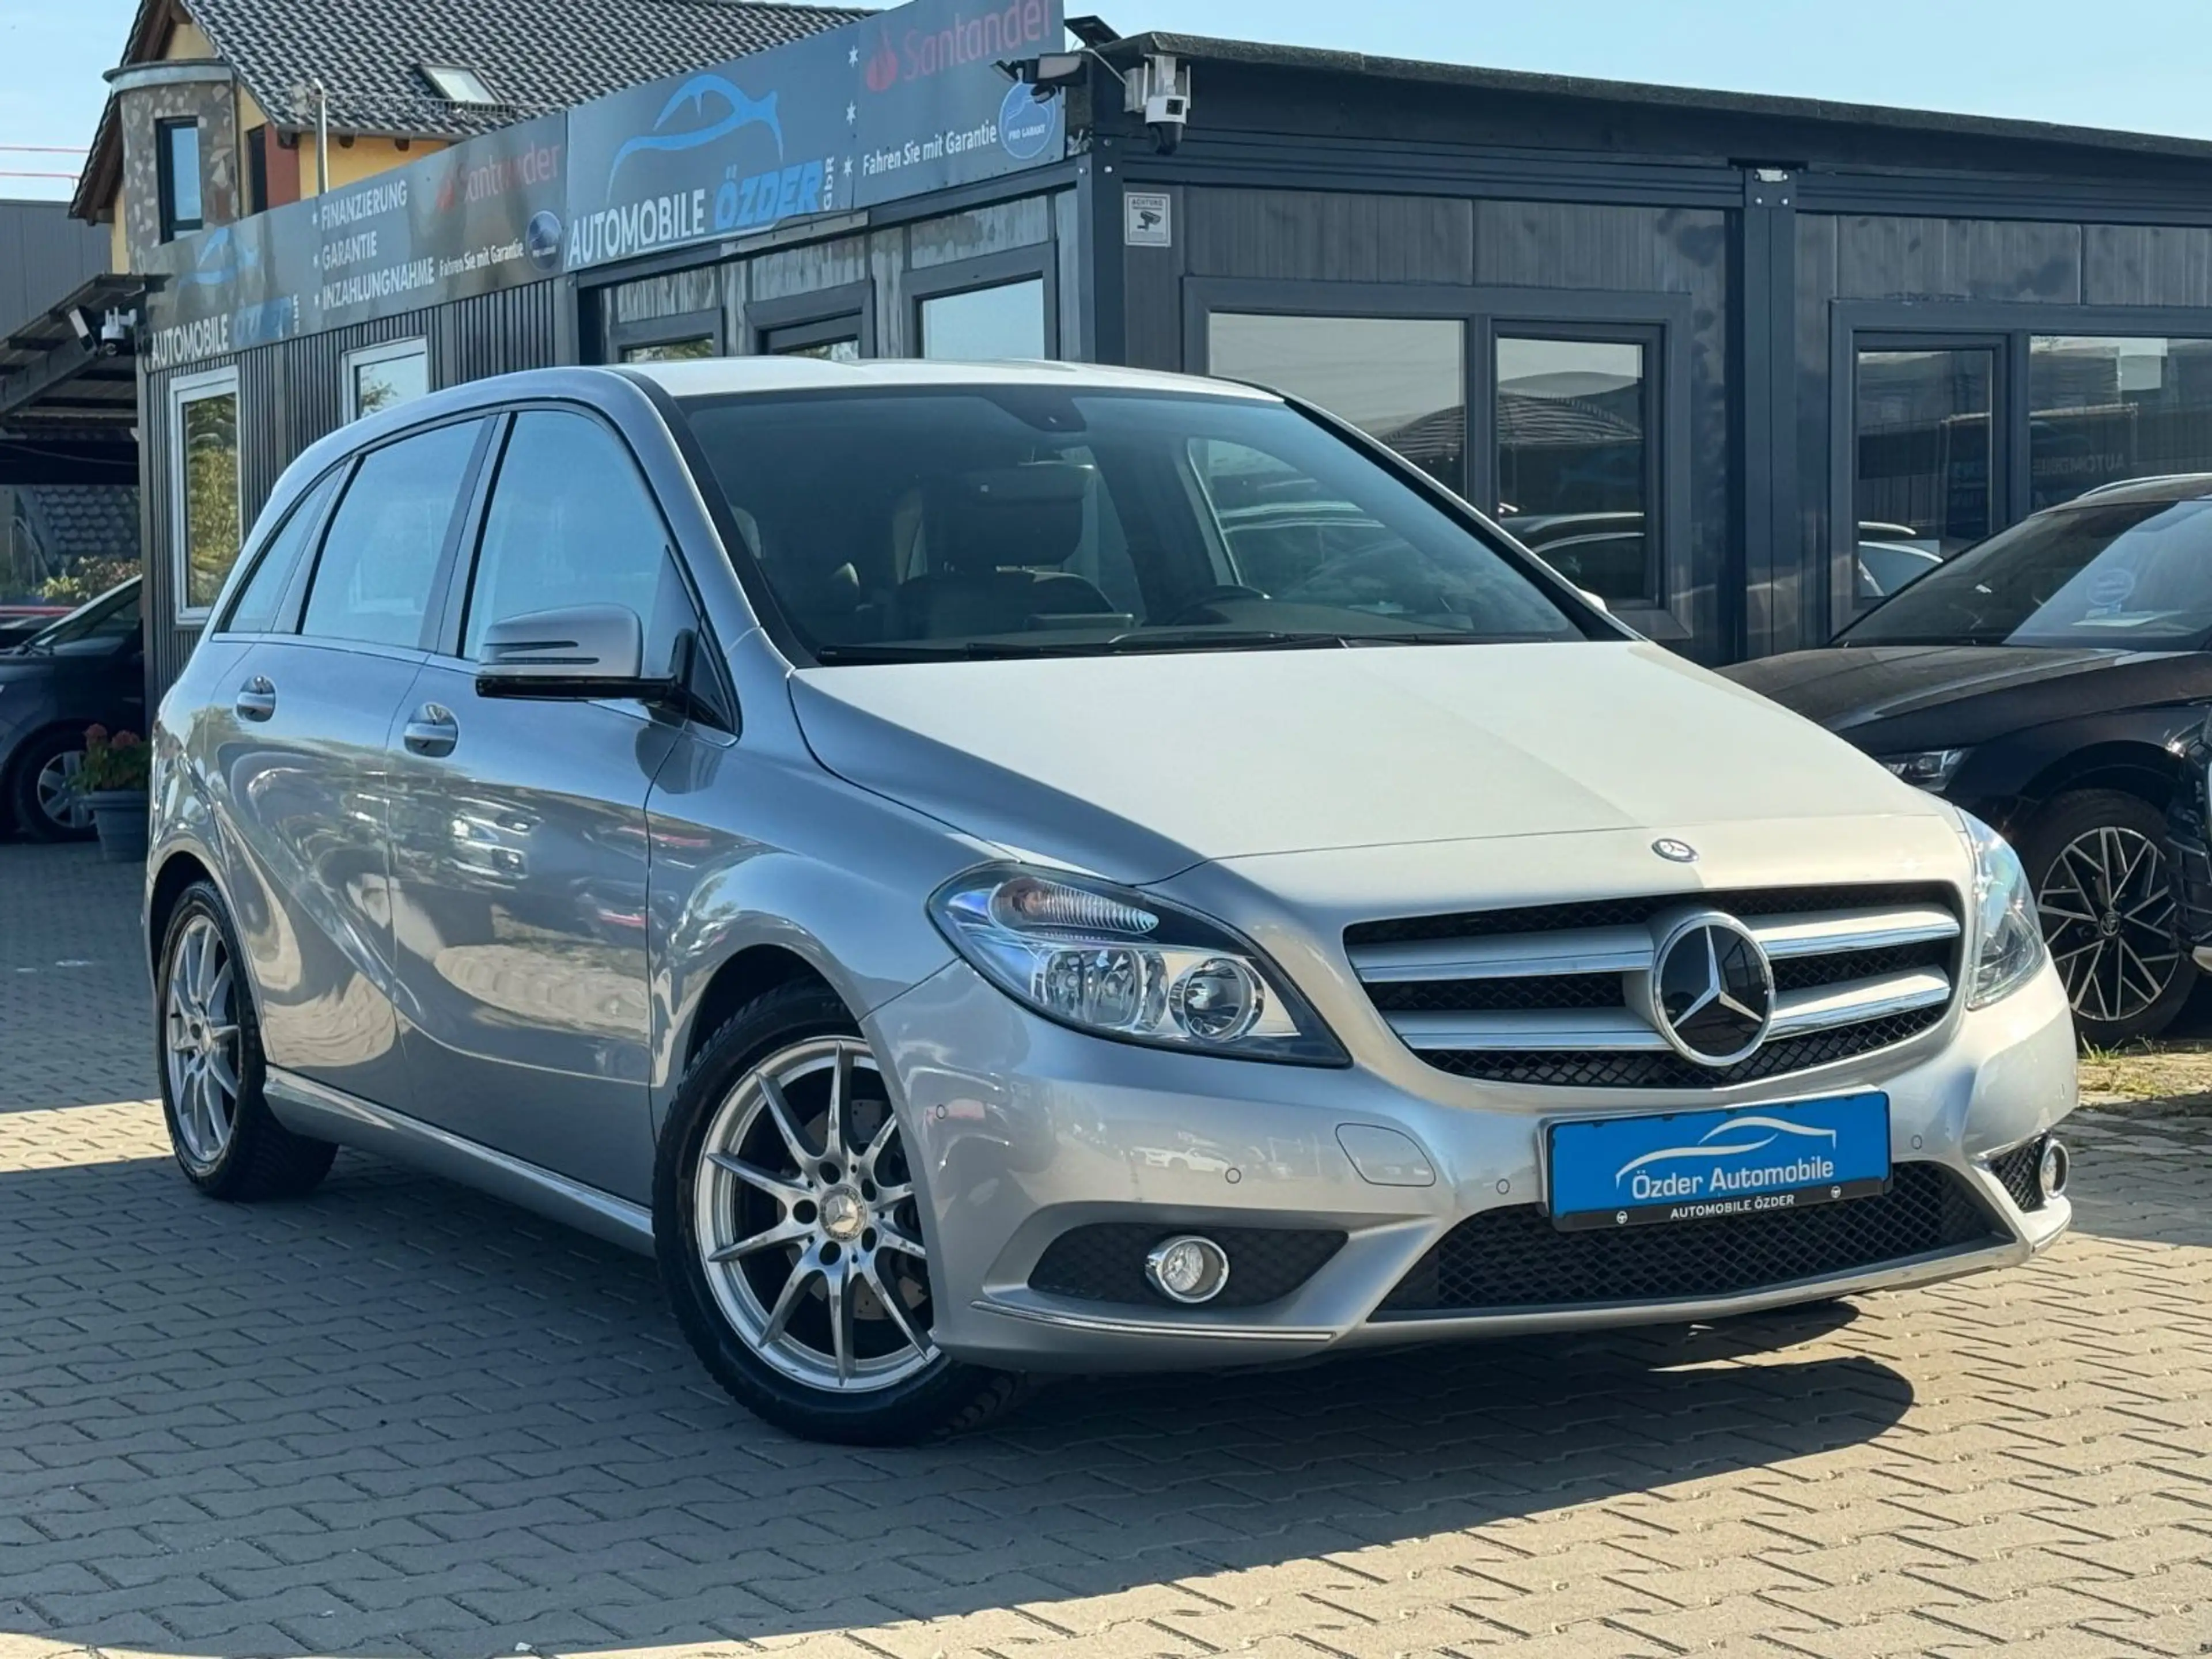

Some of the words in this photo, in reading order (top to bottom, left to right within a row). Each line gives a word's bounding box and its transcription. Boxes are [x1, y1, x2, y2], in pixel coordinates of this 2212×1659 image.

[904, 0, 1051, 81] Santander
[863, 149, 901, 176] Fahren
[903, 140, 920, 165] Sie
[923, 134, 943, 161] mit
[946, 119, 997, 154] Garantie
[321, 179, 407, 230] FINANZIERUNG
[823, 156, 835, 210] GbR
[568, 188, 705, 266] AUTOMOBILE
[715, 160, 823, 230] ÖZDER
[323, 231, 377, 270] GARANTIE
[440, 256, 464, 278] Fahren
[464, 249, 476, 271] Sie
[476, 245, 490, 268] mit
[491, 238, 524, 264] Garantie
[323, 257, 434, 310] INZAHLUNGNAHME
[151, 313, 229, 369] AUTOMOBILE
[1633, 1169, 1703, 1199] Özder
[1709, 1156, 1834, 1192] Automobile
[1670, 1200, 1751, 1219] AUTOMOBILE
[1754, 1194, 1795, 1210] ÖZDER
